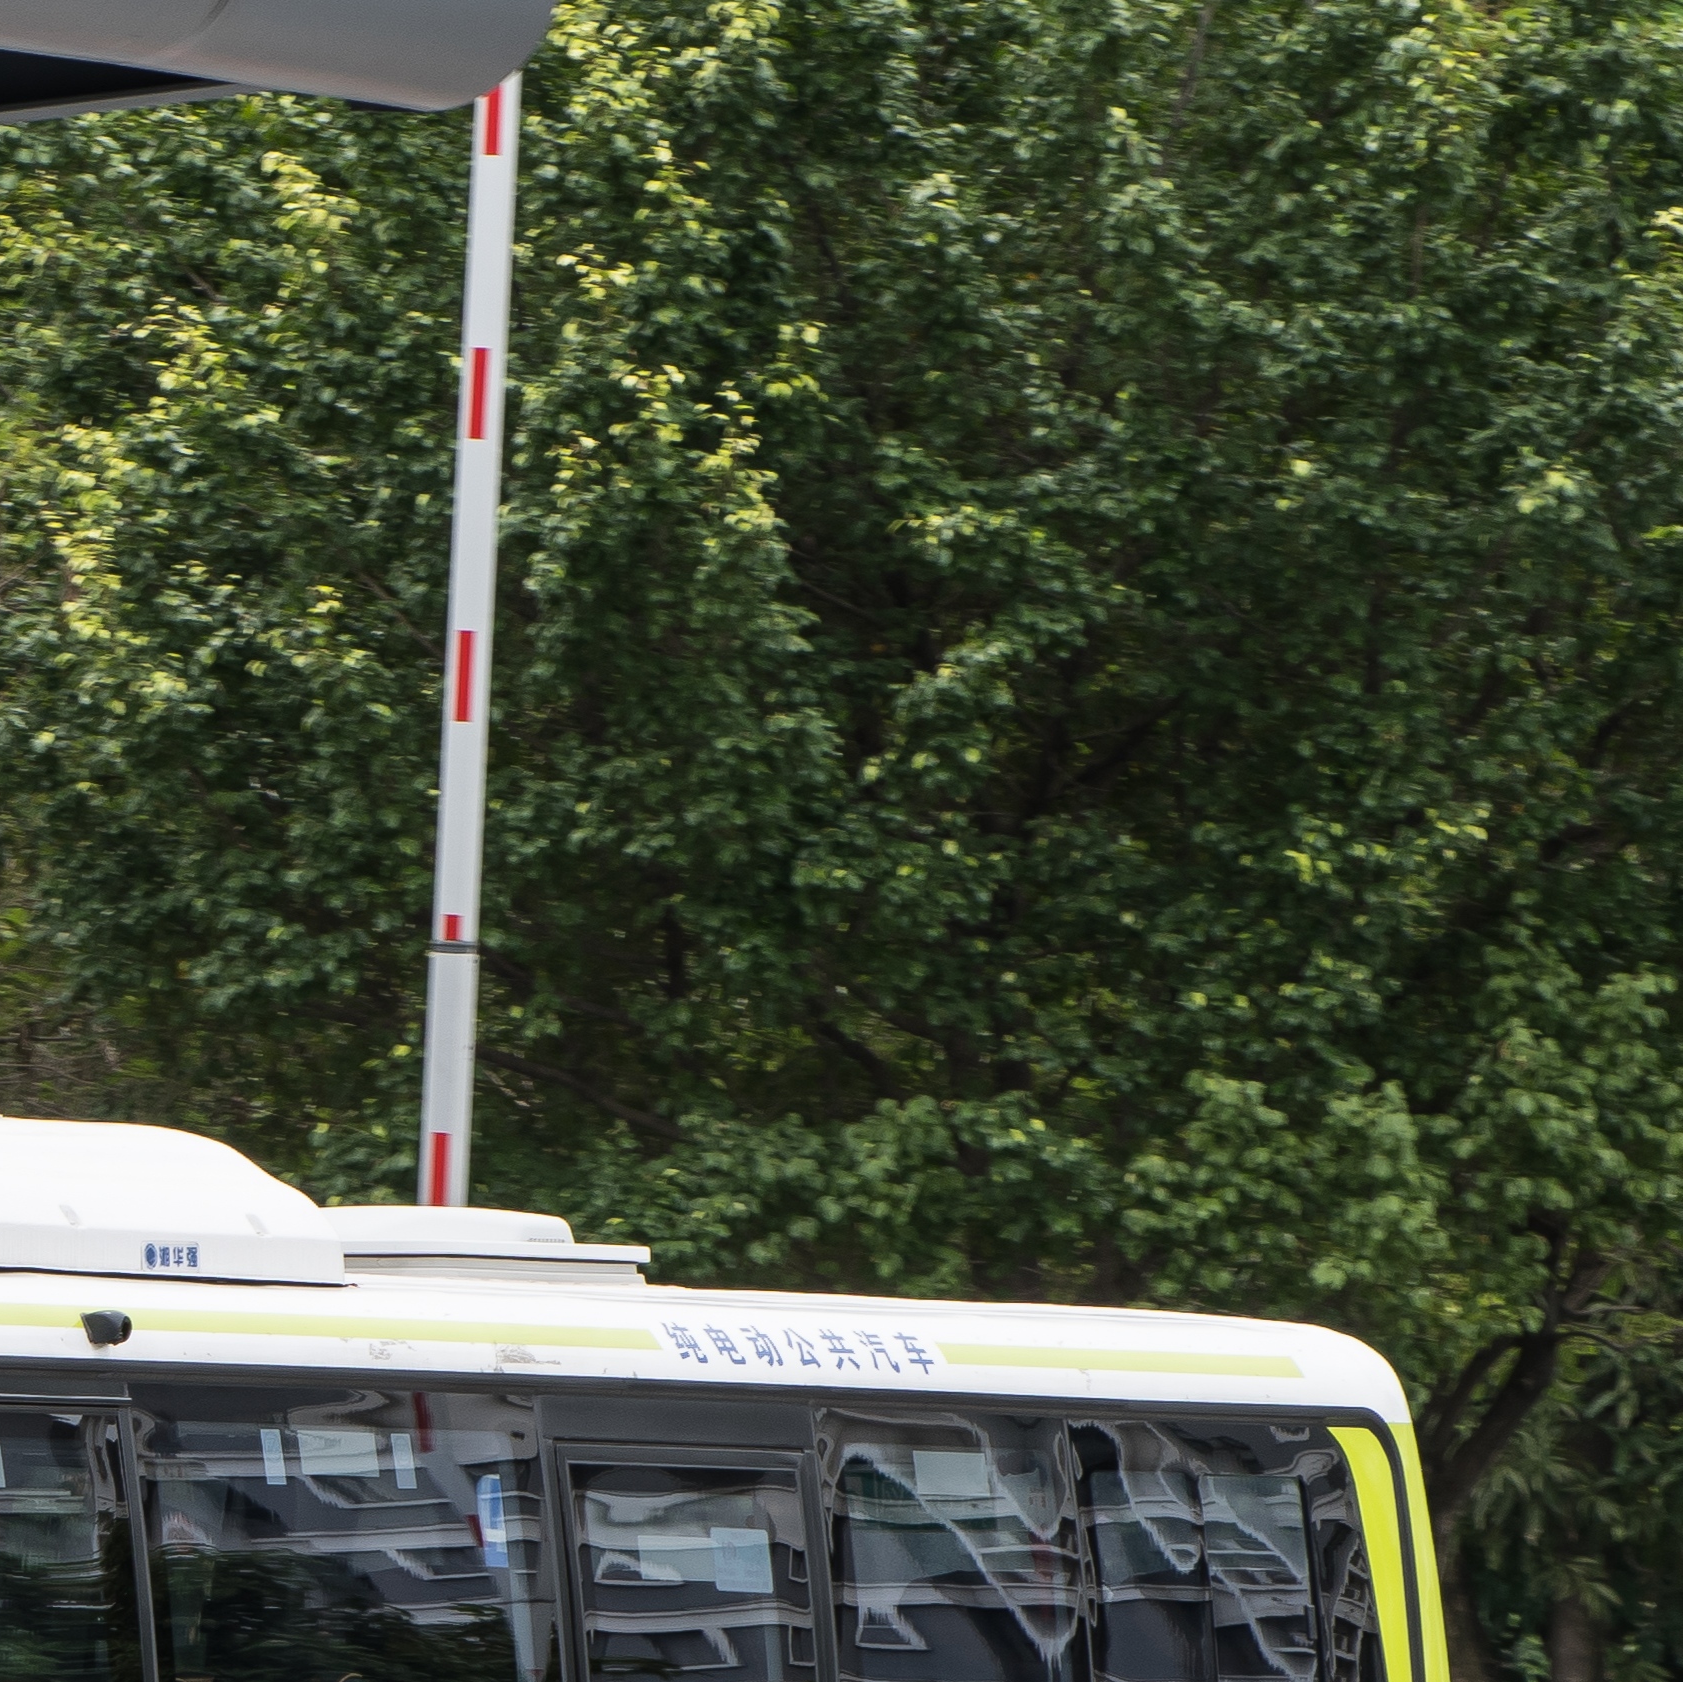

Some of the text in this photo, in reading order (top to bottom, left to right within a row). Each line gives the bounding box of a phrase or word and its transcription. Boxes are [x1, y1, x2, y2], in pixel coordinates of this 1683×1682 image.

[660, 1321, 935, 1376] 纯电动公共汽车
